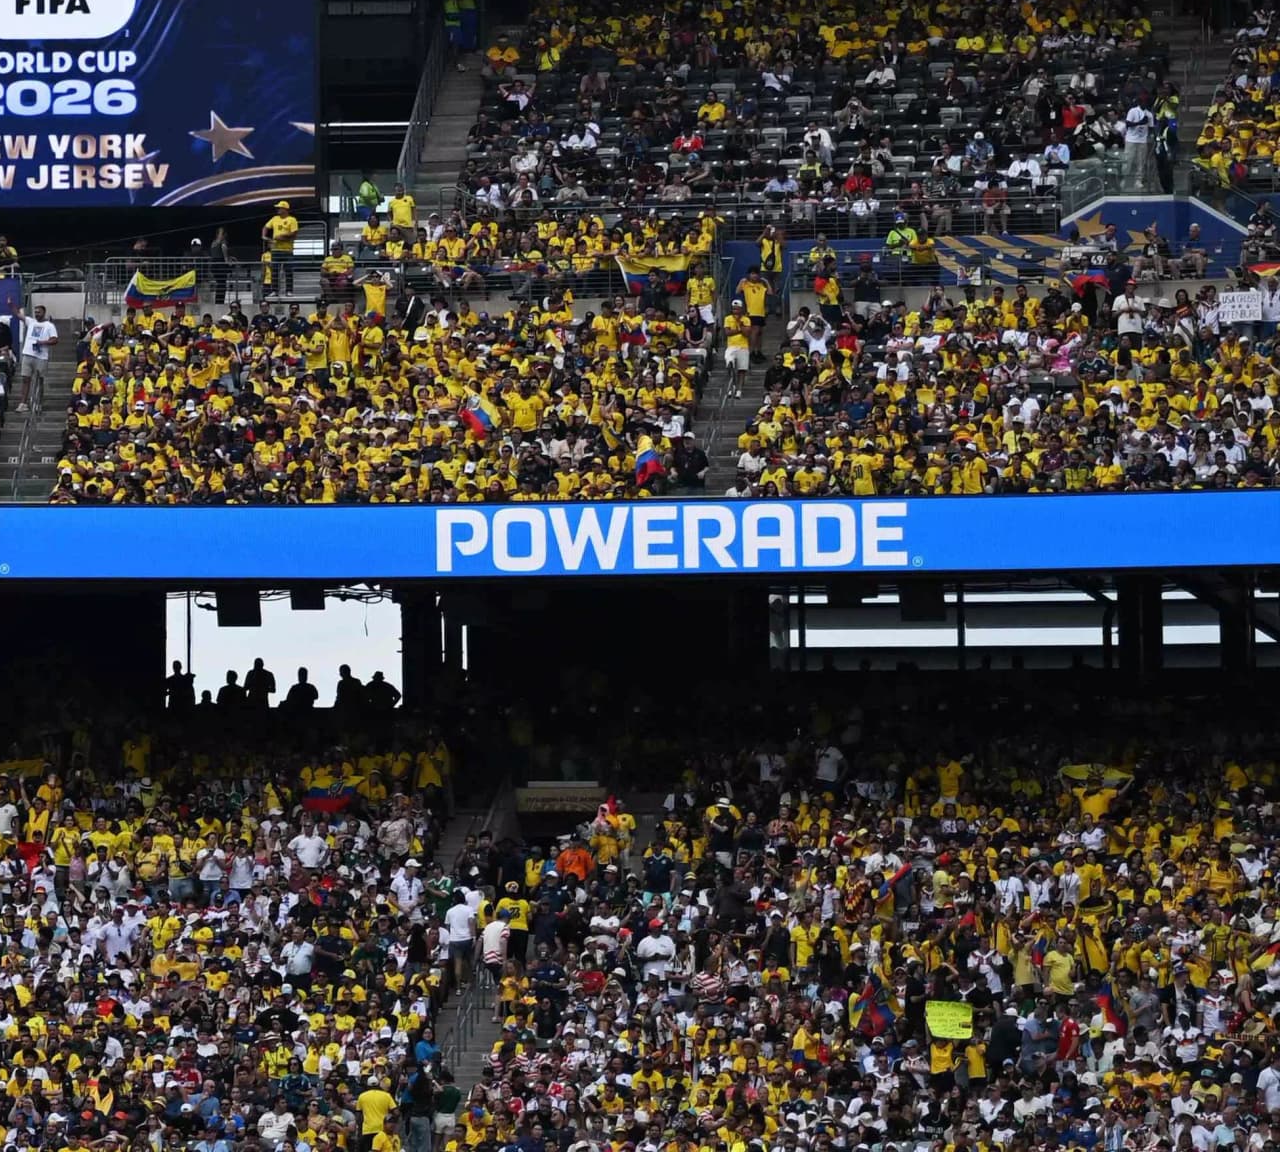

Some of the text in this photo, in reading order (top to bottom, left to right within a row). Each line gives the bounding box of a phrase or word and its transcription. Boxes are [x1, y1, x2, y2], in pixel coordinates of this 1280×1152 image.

[77, 51, 137, 73] CUP
[48, 134, 146, 159] YORK
[26, 163, 169, 189] JERSEY
